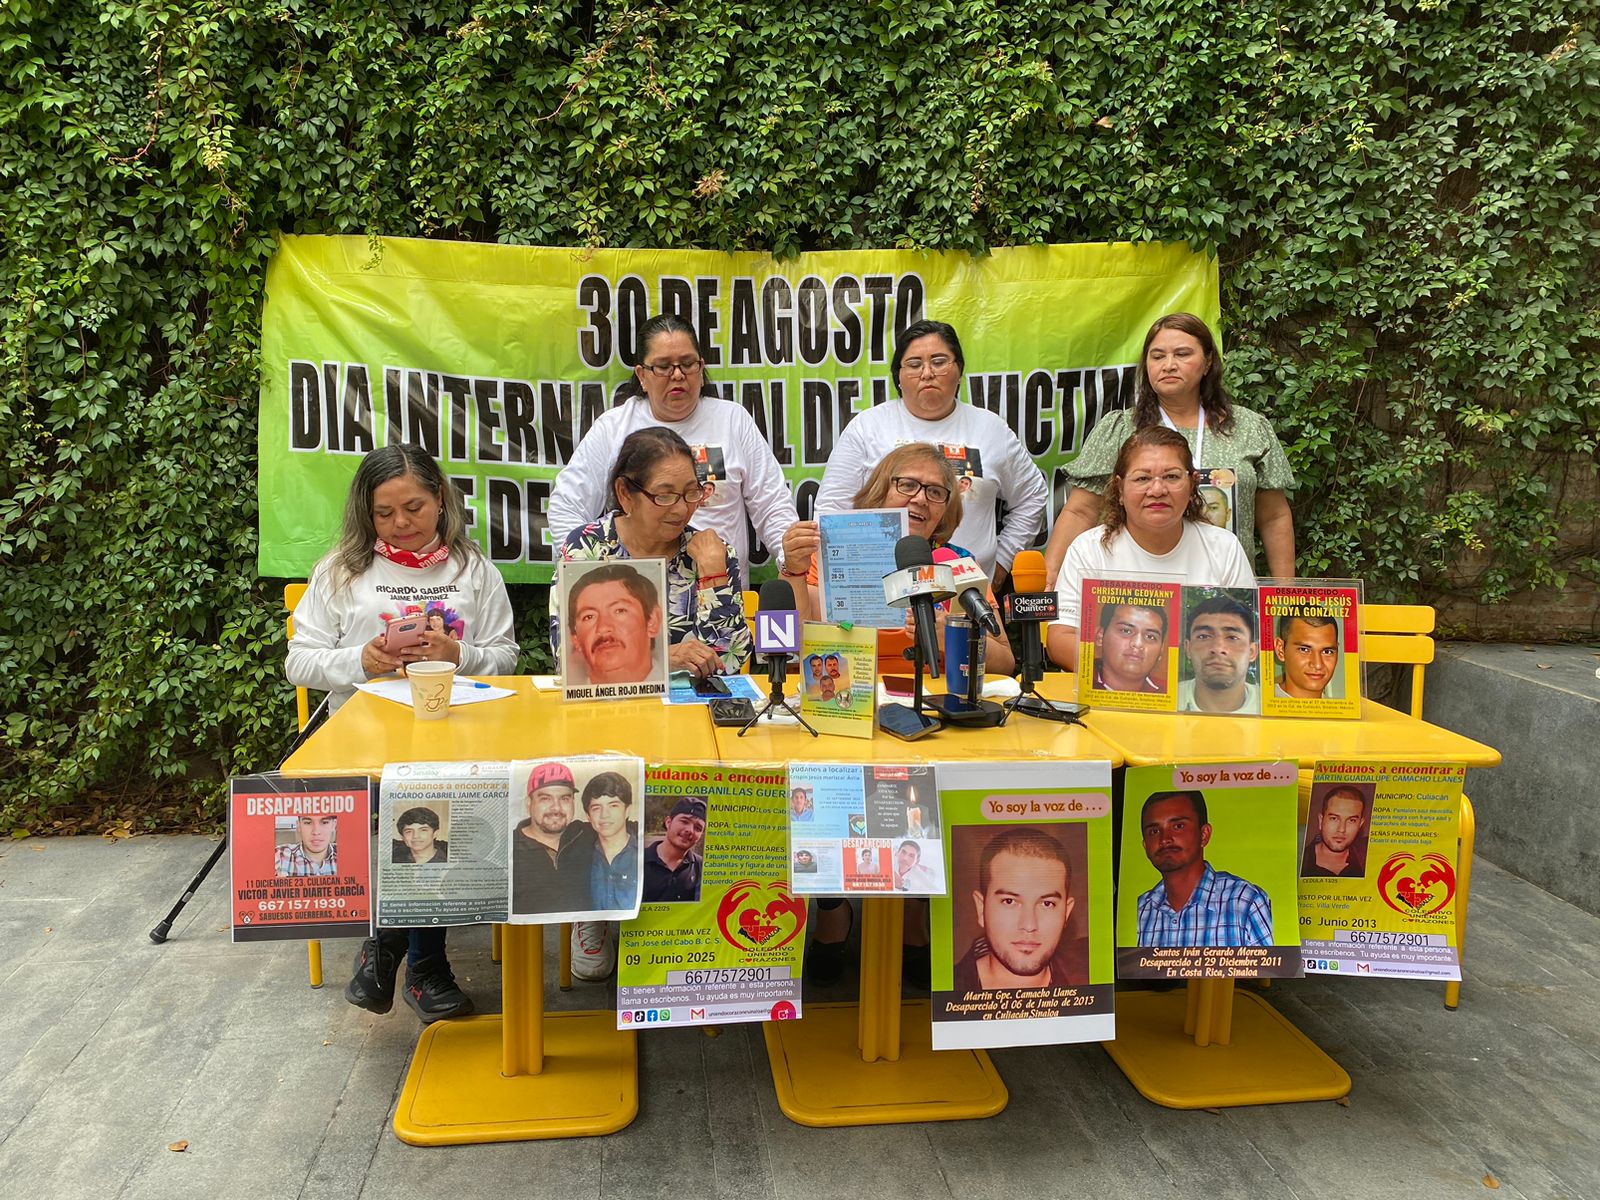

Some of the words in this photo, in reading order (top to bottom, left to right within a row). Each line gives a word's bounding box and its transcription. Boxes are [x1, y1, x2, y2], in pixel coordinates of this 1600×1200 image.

[577, 274, 650, 368] 30
[290, 361, 375, 454] DIA
[908, 565, 934, 581] TM
[376, 585, 417, 594] RICARDO
[420, 585, 459, 594] GABRIEL
[1100, 580, 1163, 590] DESAPARECIDO
[1091, 587, 1132, 596] CHRISTIAN
[1134, 589, 1174, 598] GEOVANNY
[1276, 588, 1338, 596] DESAPARECIDO
[1014, 597, 1053, 606] Olegario
[1097, 596, 1125, 605] LOZOYA
[1265, 595, 1306, 605] ANTONIO
[1309, 596, 1321, 606] DE
[1325, 594, 1352, 607] JESÚS
[1265, 606, 1300, 616] LOZOYA
[1303, 605, 1350, 617] GONZÁLEZ
[760, 614, 795, 649] LN
[566, 688, 593, 699] MIGUEL
[595, 685, 617, 697] ÁNGEL
[618, 685, 637, 695] ROJO
[639, 684, 665, 694] MEDINA
[645, 768, 708, 781] yudanos
[714, 772, 722, 782] a
[728, 772, 786, 785] encontr
[1180, 771, 1194, 783] Yo
[1197, 773, 1217, 784] soy
[1220, 770, 1230, 781] la
[1233, 772, 1254, 782] voz
[1379, 766, 1387, 774] a
[1391, 766, 1453, 775] encontrar
[457, 791, 481, 799] JAIME
[685, 786, 753, 796] CABANILLAS
[247, 795, 354, 815] DESAPARECIDO
[989, 800, 1003, 813] Yo
[1006, 803, 1027, 815] soy
[1030, 800, 1041, 812] la
[1043, 802, 1065, 813] voz
[246, 881, 253, 889] 11
[255, 879, 292, 888] DICIEMBRE
[238, 889, 268, 900] VICTOR
[271, 888, 300, 899] JAVIER
[303, 887, 331, 898] DIARTE
[334, 884, 365, 897] GARCÍA
[258, 900, 285, 911] 667
[288, 900, 311, 911] 157
[314, 898, 346, 909] 1930
[259, 912, 293, 921] SABUESOS
[1299, 916, 1312, 926] 06
[1318, 917, 1349, 927] Junio
[1351, 918, 1377, 928] 2013
[621, 930, 644, 938] VISTO
[646, 929, 664, 937] POR
[1350, 931, 1430, 946] 6677572901
[625, 940, 640, 948] San
[674, 938, 693, 946] Cabo
[1153, 947, 1180, 957] Santos
[1183, 947, 1201, 957] Iván
[1203, 947, 1234, 957] Gerardo
[1237, 946, 1268, 957] Moreno
[625, 954, 641, 966] 09
[648, 952, 683, 965] Junio
[687, 951, 716, 964] 2025
[1139, 957, 1191, 971] Desaparecido
[1194, 957, 1202, 967] el
[1204, 957, 1217, 967] 29
[1219, 956, 1258, 967] Diciembre
[1260, 956, 1282, 967] 2011
[685, 967, 772, 985] 6677572901
[1166, 968, 1177, 977] En
[1180, 967, 1202, 977] Costa
[1205, 967, 1225, 979] Rica,
[1227, 967, 1258, 977] Sinaloa
[621, 988, 630, 996] Si
[633, 986, 656, 995] tienes
[705, 982, 737, 991] referente
[749, 981, 764, 989] esta
[621, 997, 642, 1006] llama
[696, 993, 705, 1001] Tu
[706, 992, 729, 1002] ayuda
[739, 991, 755, 1001] muy
[963, 991, 992, 1001] Martin
[995, 990, 1013, 1004] Gpe.
[1015, 988, 1051, 999] Camacho
[1053, 987, 1078, 998] Llanes
[946, 1000, 998, 1014] Desaparecido
[1001, 1000, 1008, 1009] el
[1011, 999, 1022, 1009] 06
[1025, 999, 1035, 1008] de
[1037, 998, 1059, 1009] Junio
[1061, 997, 1071, 1007] de
[1073, 995, 1095, 1006] 2013
[982, 1012, 992, 1020] en
